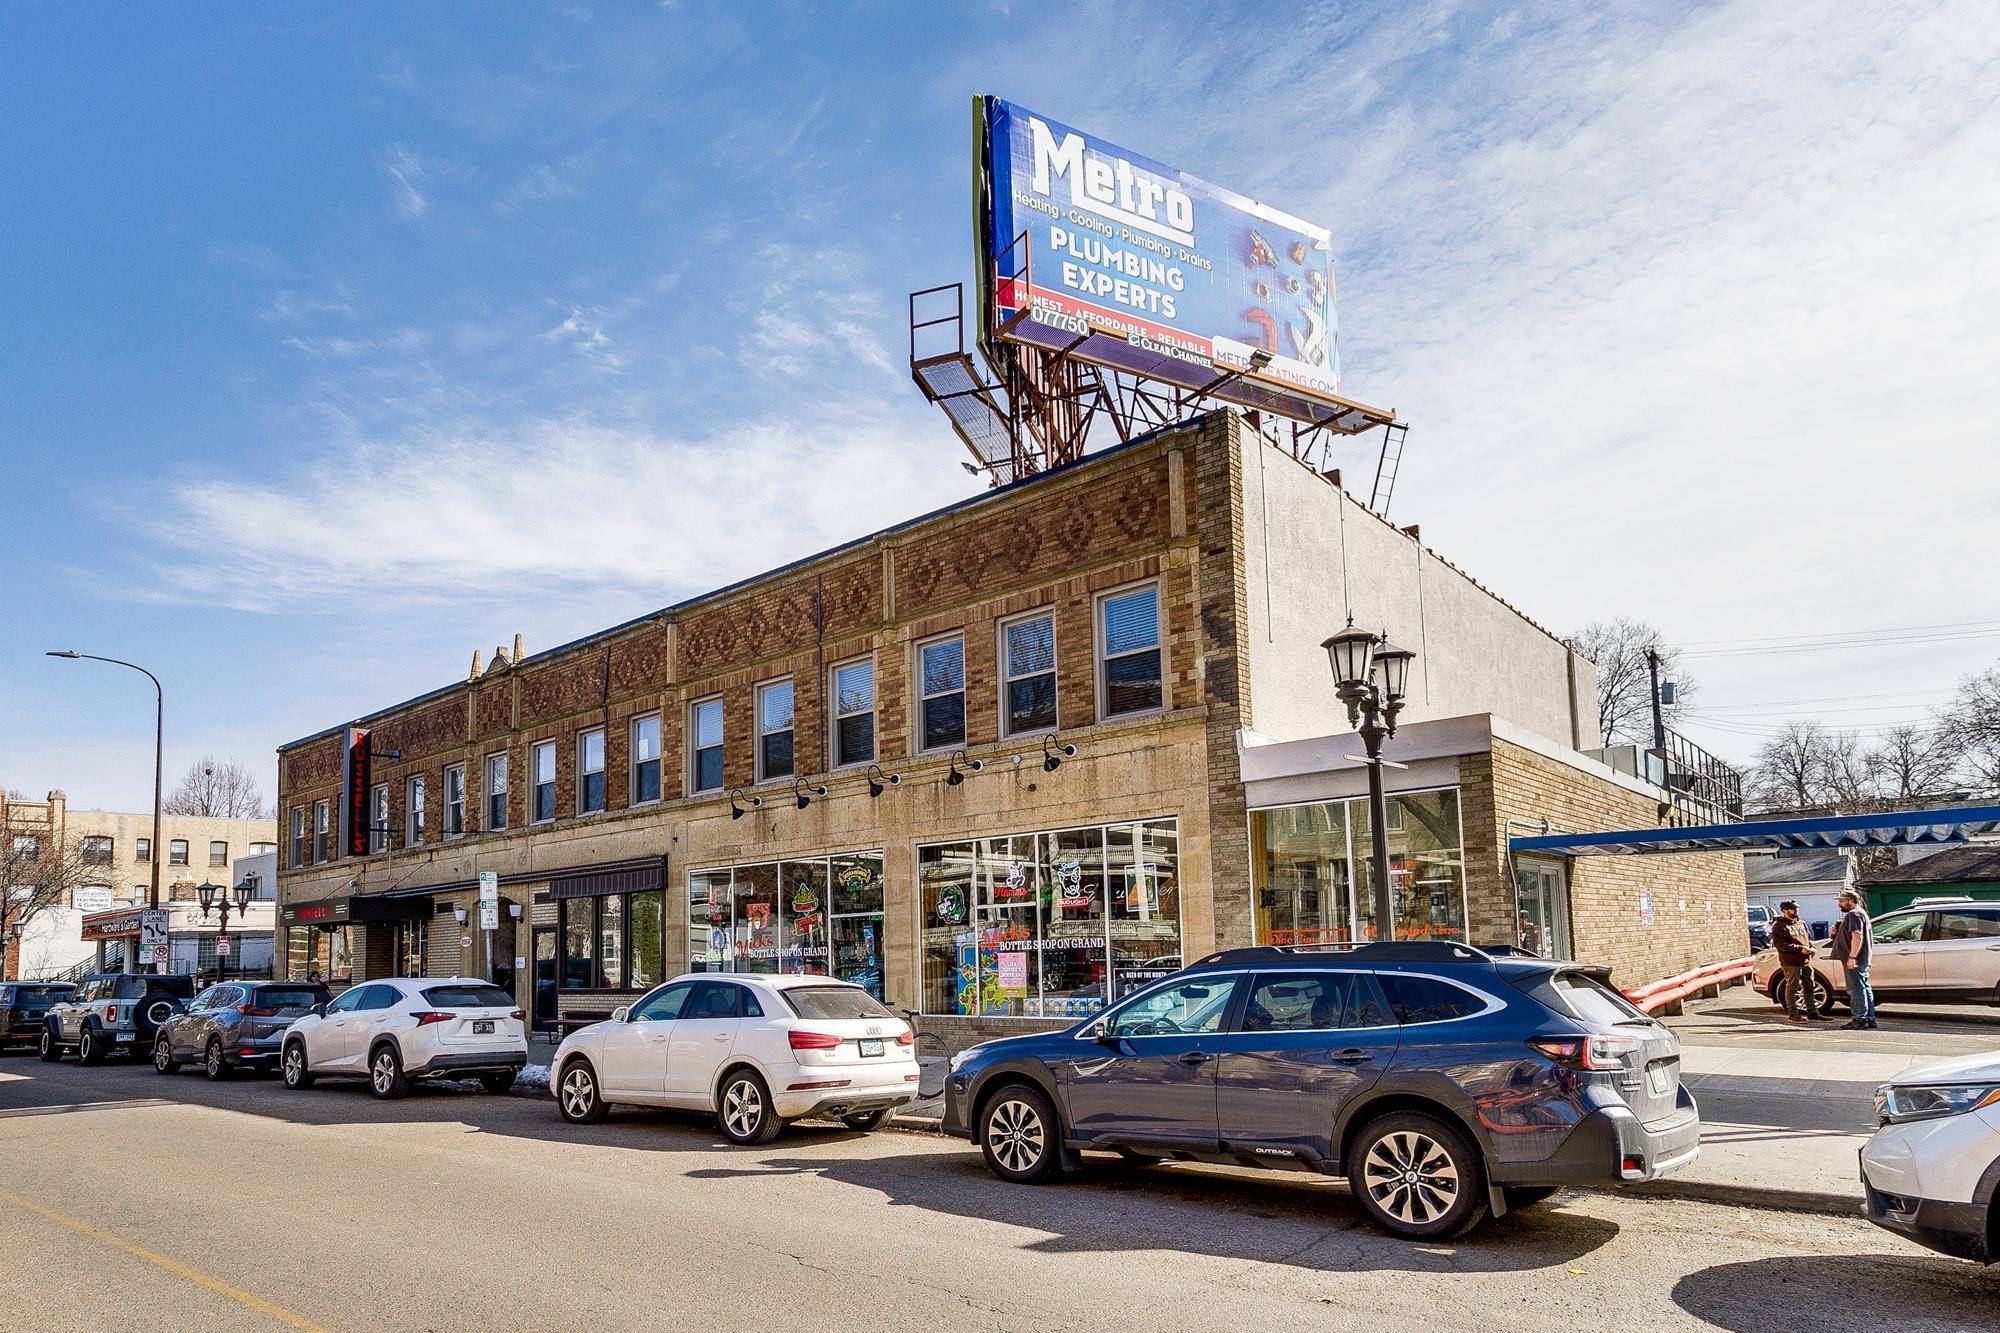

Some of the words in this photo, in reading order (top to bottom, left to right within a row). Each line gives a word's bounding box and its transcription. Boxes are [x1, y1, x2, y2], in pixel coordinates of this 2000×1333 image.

[1028, 116, 1195, 247] Metro
[1014, 191, 1060, 220] Heating
[1069, 209, 1113, 238] Cooling
[1122, 229, 1171, 259] Plumbing
[1179, 248, 1212, 271] Drains
[1051, 226, 1185, 292] PLUMBING
[1063, 262, 1178, 320] EXPERTS
[1032, 306, 1088, 336] 077750
[1075, 308, 1148, 337] AFFORDABLE
[1158, 334, 1207, 355] RELIABLE
[750, 948, 775, 958] BOTTLE
[775, 947, 793, 957] SHOP
[803, 946, 828, 957] GRAND
[1000, 940, 1032, 951] BOTTLE
[1033, 939, 1057, 950] SHOP
[1057, 939, 1070, 949] ON
[1071, 938, 1104, 949] GRAND
[1255, 1147, 1294, 1156] OUTBACK
